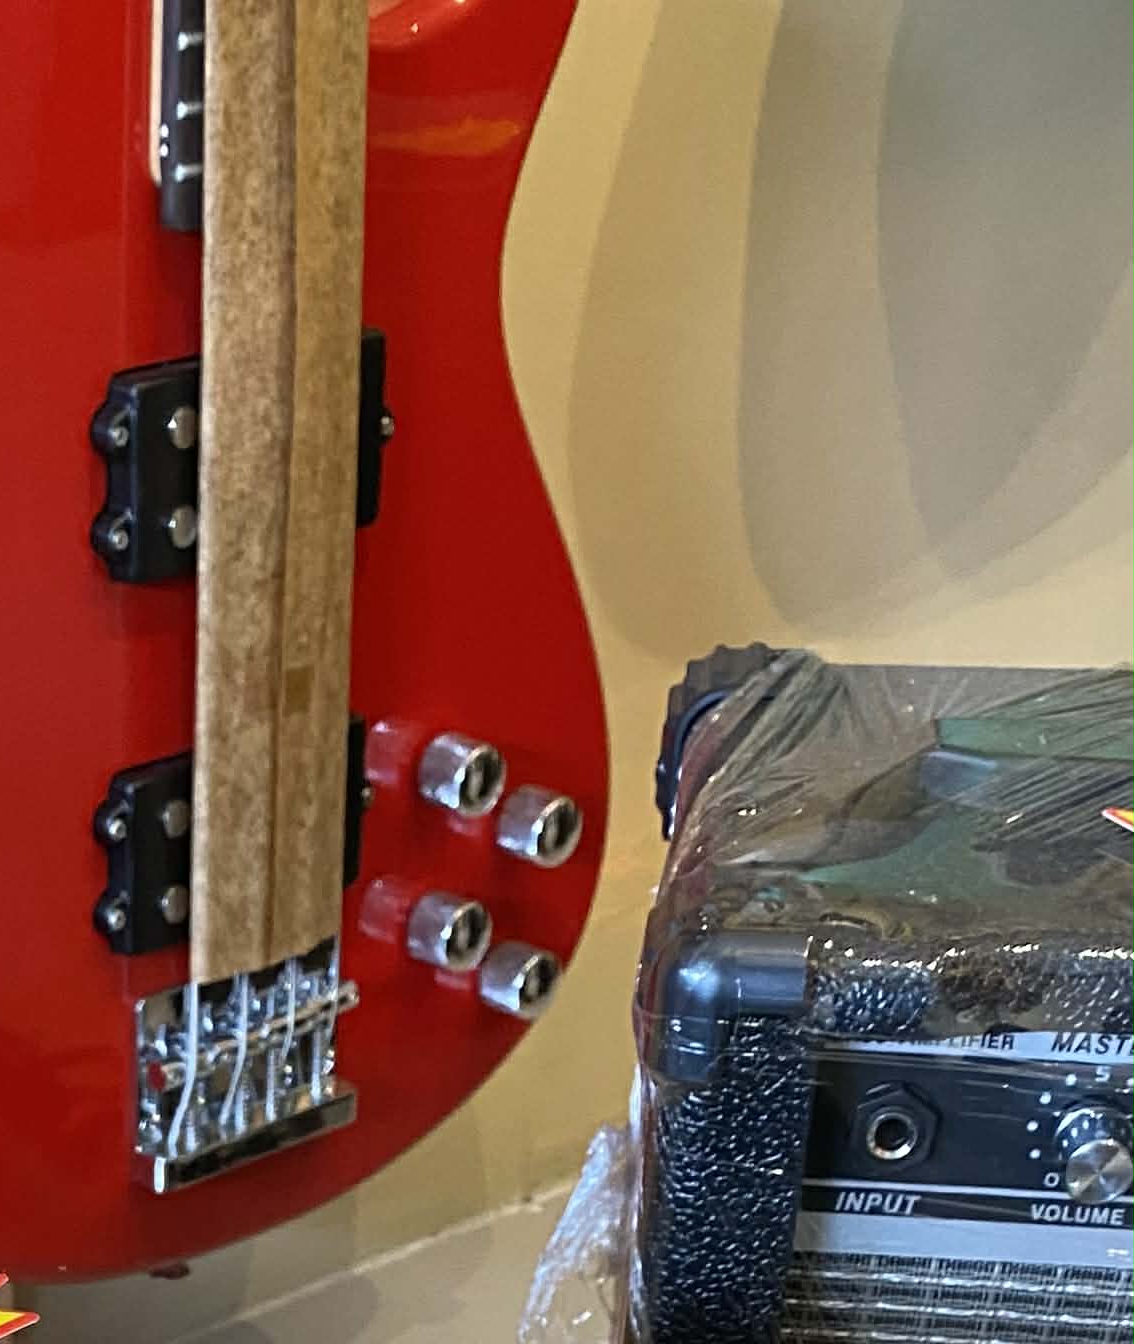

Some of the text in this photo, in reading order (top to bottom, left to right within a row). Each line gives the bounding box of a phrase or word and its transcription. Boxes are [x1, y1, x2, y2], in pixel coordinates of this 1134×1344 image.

[898, 1031, 1134, 1056] LIFIER MAST
[1095, 1066, 1111, 1083] 5
[834, 1191, 922, 1216] INPUT
[1030, 1204, 1126, 1226] VOLUME
